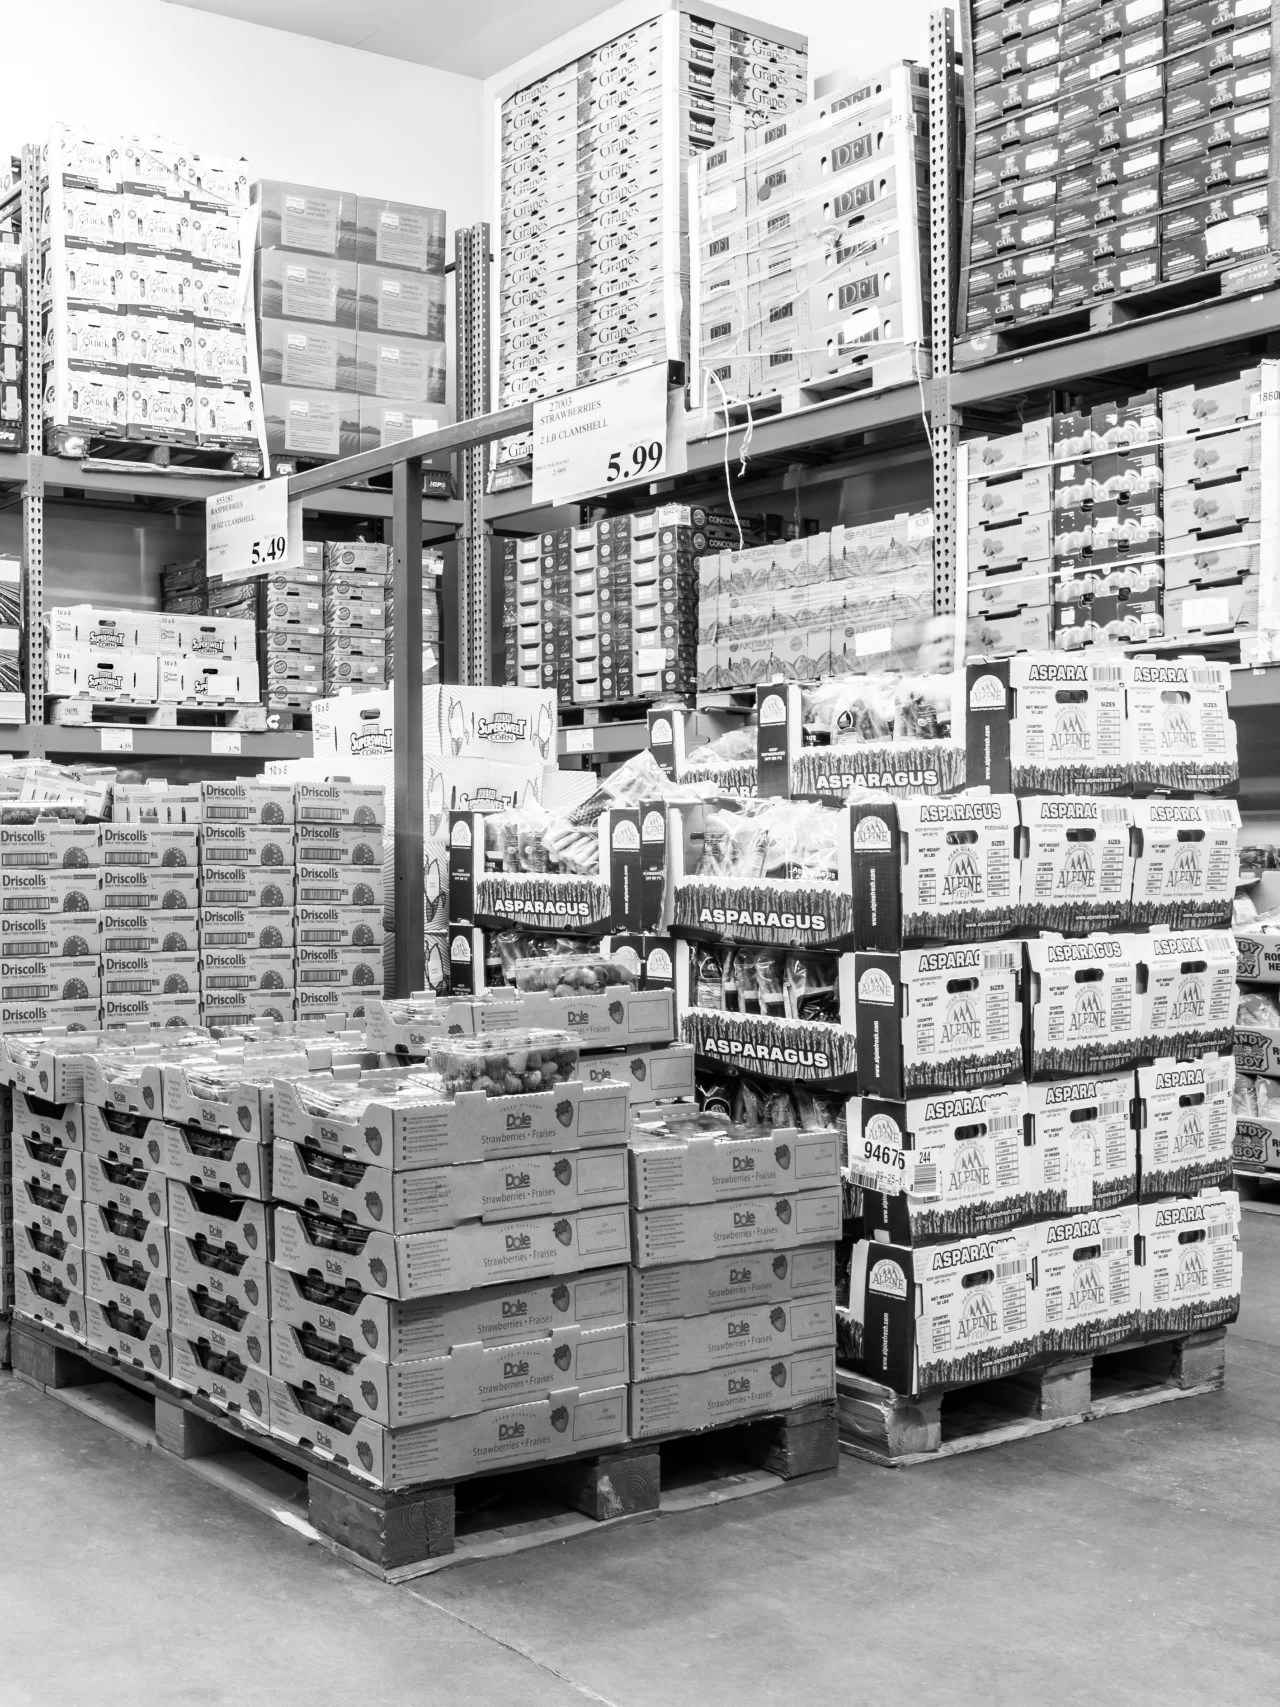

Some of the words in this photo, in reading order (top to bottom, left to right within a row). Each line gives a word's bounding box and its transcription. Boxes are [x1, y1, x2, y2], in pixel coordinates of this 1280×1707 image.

[1002, 24, 1022, 36] CAPA
[752, 38, 788, 60] Grapes
[1209, 55, 1234, 68] CAPA
[599, 64, 638, 86] Grapes
[752, 63, 788, 85] Grapes
[752, 88, 788, 109] Grapes
[514, 109, 548, 129] Grapes
[766, 125, 786, 143] DFI
[833, 135, 870, 171] DFI
[1205, 172, 1229, 183] CAPA
[836, 183, 874, 215] DFI
[841, 275, 878, 303] DFI
[995, 303, 1014, 315] CAPA
[540, 400, 602, 425] STRAWBERRIES
[550, 397, 572, 411] 27003
[540, 436, 544, 445] 2
[547, 433, 557, 443] LB
[559, 419, 608, 440] CLAMSHELL
[607, 441, 663, 482] 5.99
[211, 502, 243, 515] RASPBERRIES
[225, 514, 255, 526] CLAMSHELL
[252, 537, 285, 564] 5.49
[494, 712, 512, 723] FRESH
[478, 718, 527, 736] SUPERSWEET
[490, 733, 514, 741] CORN
[816, 770, 938, 790] ASPARAGUS
[206, 784, 247, 798] Driscoll's
[920, 803, 1001, 822] ASPARAGUS
[1, 830, 45, 842] Driscoll's
[105, 829, 149, 843] Driscoll's
[205, 826, 247, 839] Driscoll's
[2, 874, 46, 886] Driscoll's
[943, 876, 983, 895] ALPINE
[494, 899, 590, 916] ASPARAGUS
[699, 908, 826, 931] ASPARAGUS
[1048, 941, 1121, 962] ASPARAGUS
[940, 1021, 981, 1043] ALPINE
[1069, 1012, 1106, 1034] ALPINE
[705, 1038, 829, 1069] ASPARAGUS
[506, 1112, 531, 1127] Dole
[482, 1133, 526, 1145] Strawberries
[532, 1129, 556, 1138] Fraises
[733, 1154, 755, 1169] Dole
[864, 1141, 905, 1170] 94676
[919, 1151, 931, 1164] 244
[712, 1174, 751, 1185] Strawberries
[755, 1171, 776, 1181] Fraises
[499, 1420, 525, 1437] Dole
[472, 1443, 518, 1457] Strawberries
[521, 1435, 551, 1447] Fraises
